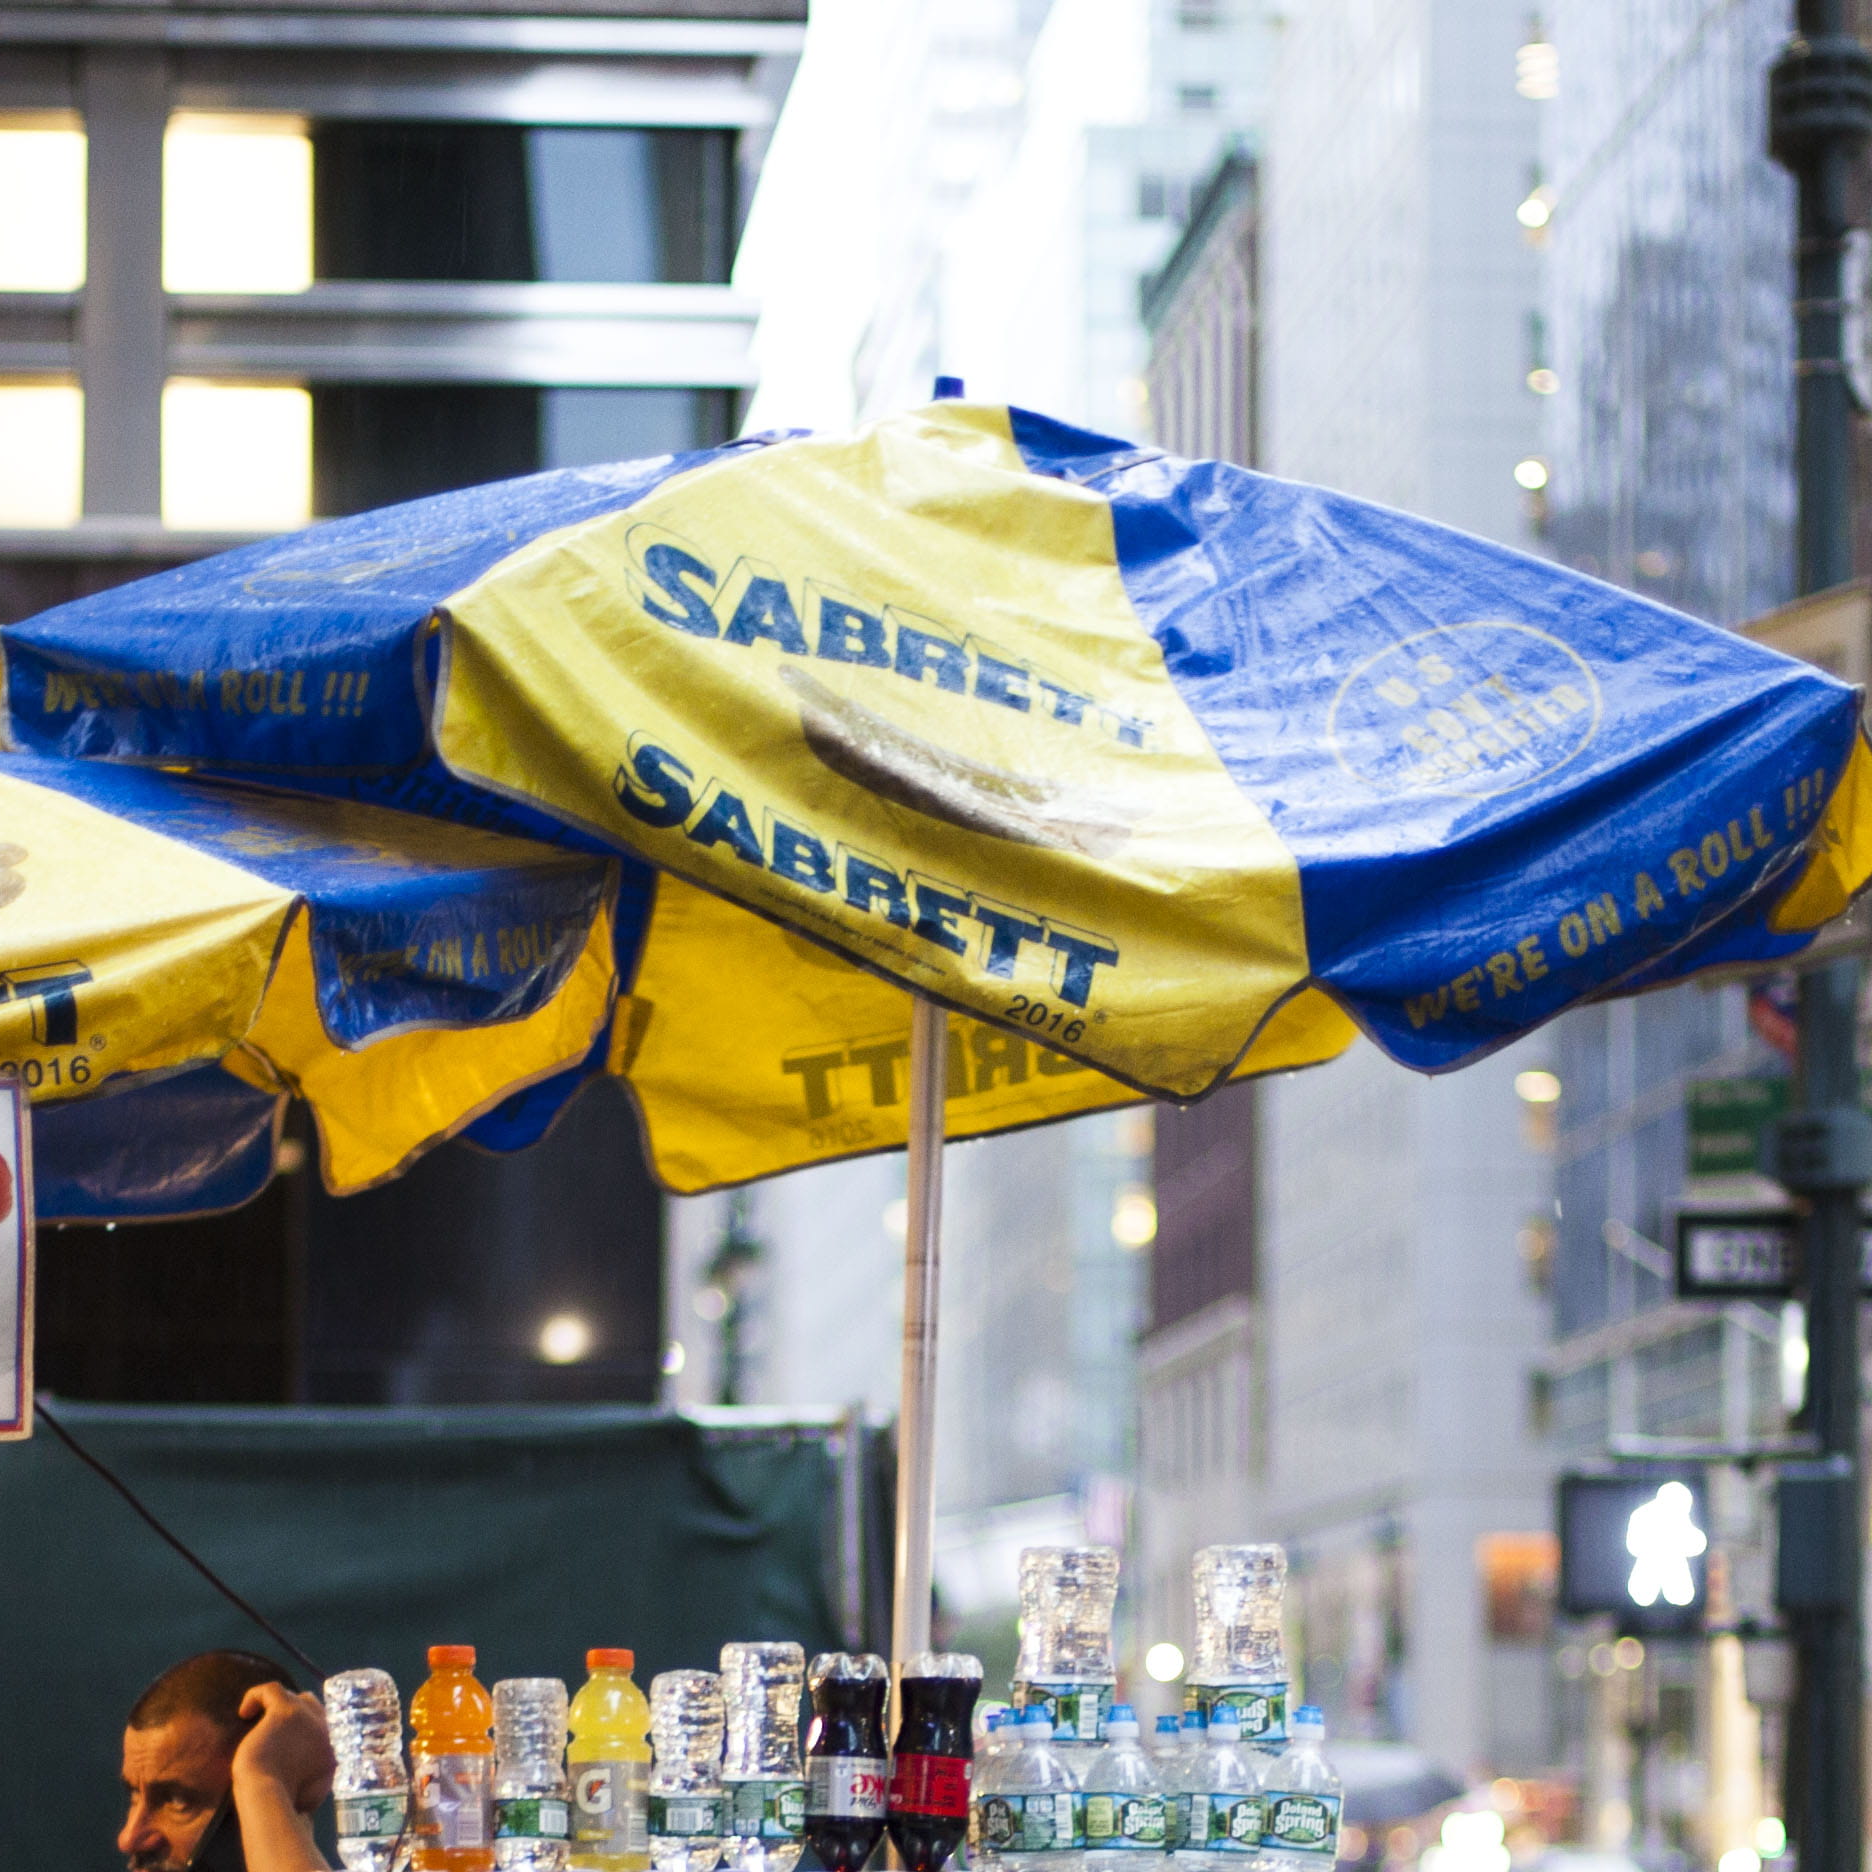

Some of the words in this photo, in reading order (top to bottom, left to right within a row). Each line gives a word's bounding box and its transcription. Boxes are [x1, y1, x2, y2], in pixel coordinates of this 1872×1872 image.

[220, 668, 308, 716] ROLL
[1396, 684, 1589, 784] SPECTED
[613, 730, 1119, 1008] SABRETT
[1403, 935, 1550, 1030] WE'RE
[1558, 893, 1623, 958] ON
[1633, 872, 1665, 919] A
[1668, 805, 1774, 896] ROLL
[471, 933, 489, 976] A
[1004, 994, 1087, 1043] 2016
[576, 1768, 611, 1814] G
[1280, 1801, 1323, 1818] Poland
[1275, 1814, 1324, 1839] Spring
